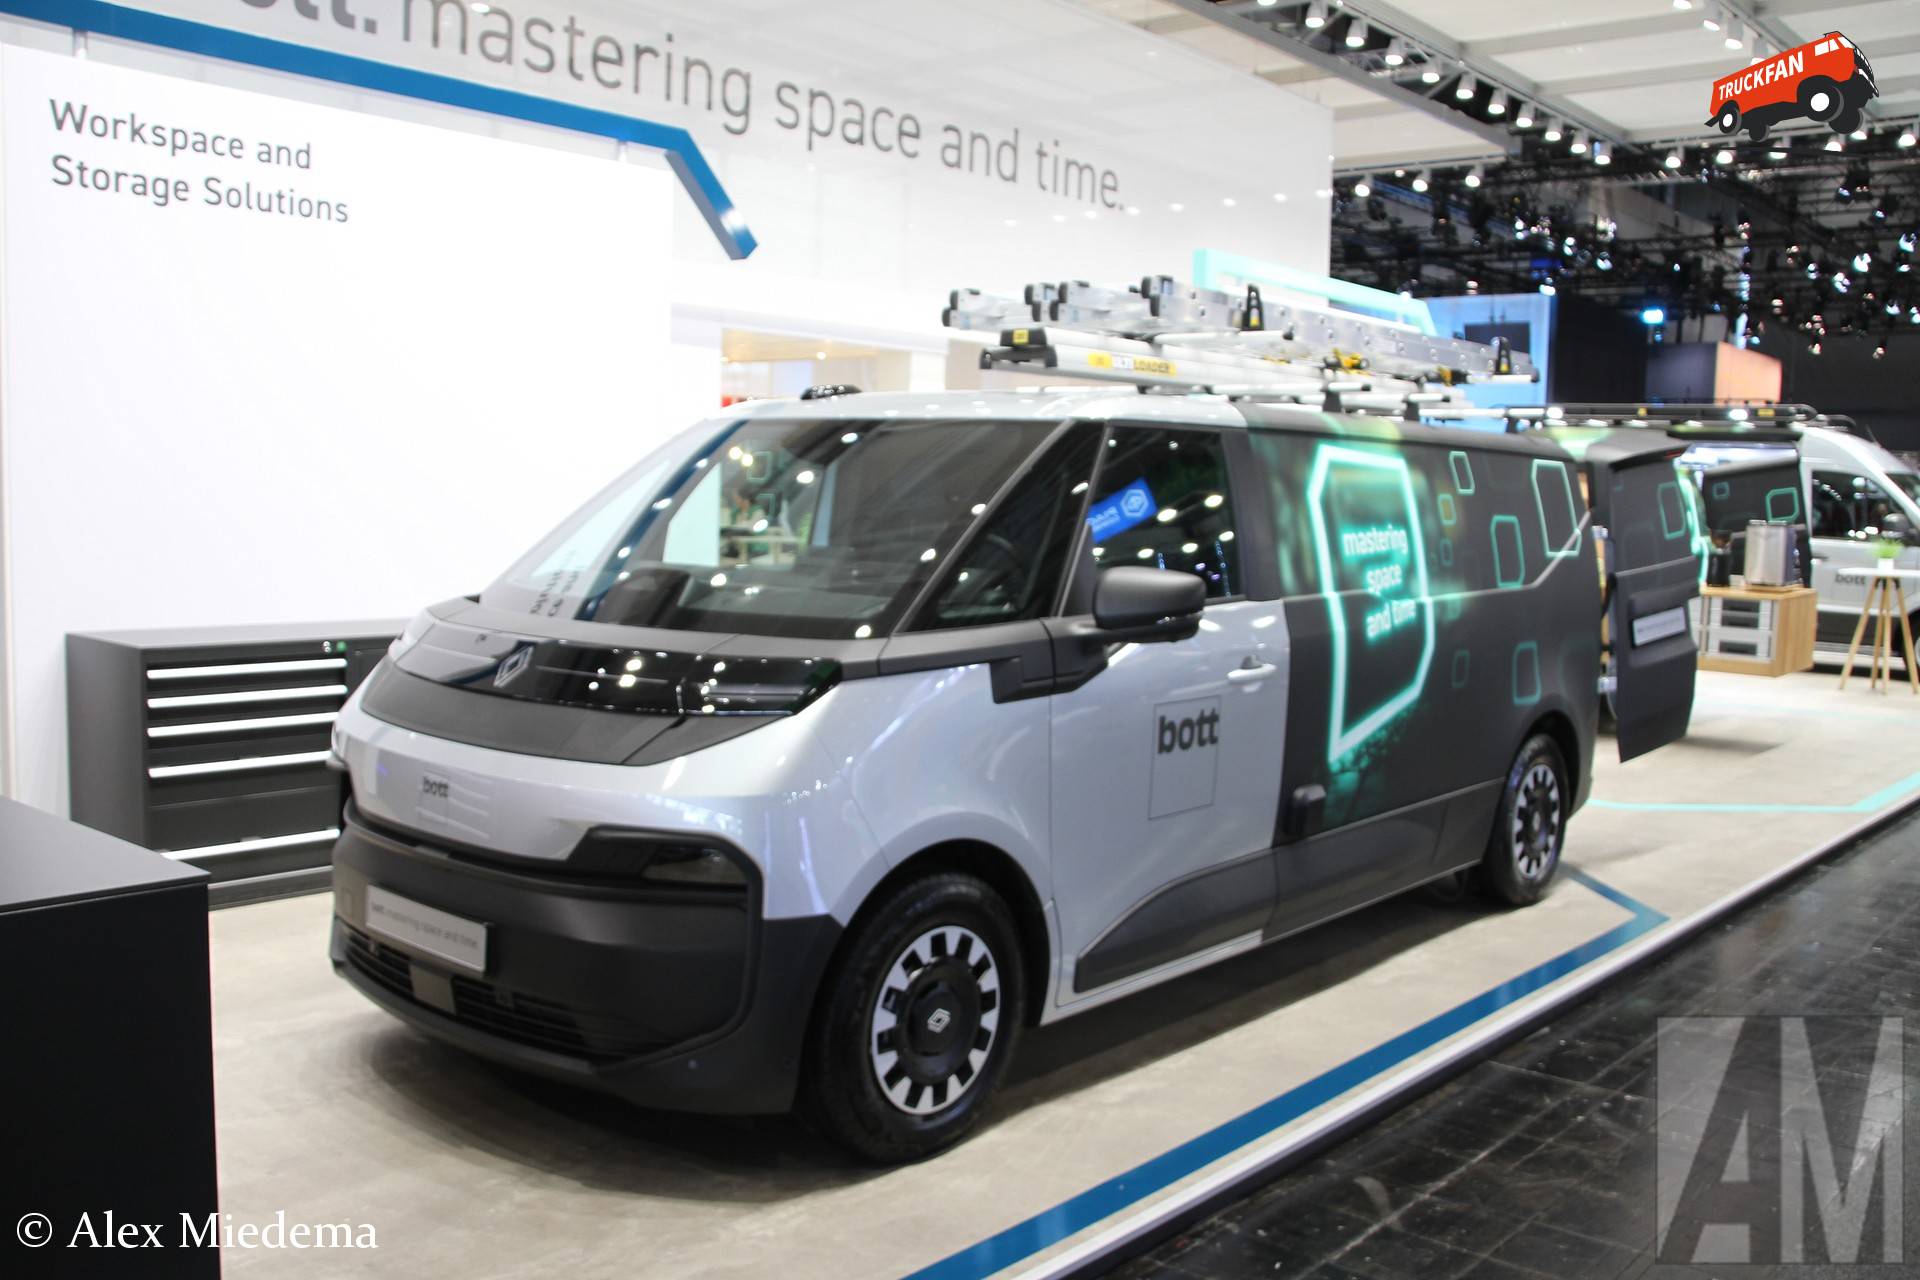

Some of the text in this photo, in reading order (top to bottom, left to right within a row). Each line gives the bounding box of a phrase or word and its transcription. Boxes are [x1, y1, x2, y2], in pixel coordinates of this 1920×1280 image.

[402, 0, 753, 136] mastering
[774, 79, 922, 158] space
[940, 124, 1019, 183] and
[1035, 139, 1125, 210] time.
[49, 98, 312, 170] Workspace and
[51, 154, 349, 223] Storage Solutions
[1343, 523, 1409, 557] mastering
[1366, 563, 1402, 597] space
[1366, 602, 1392, 639] and
[1157, 707, 1220, 755] bott
[422, 776, 449, 799] bott
